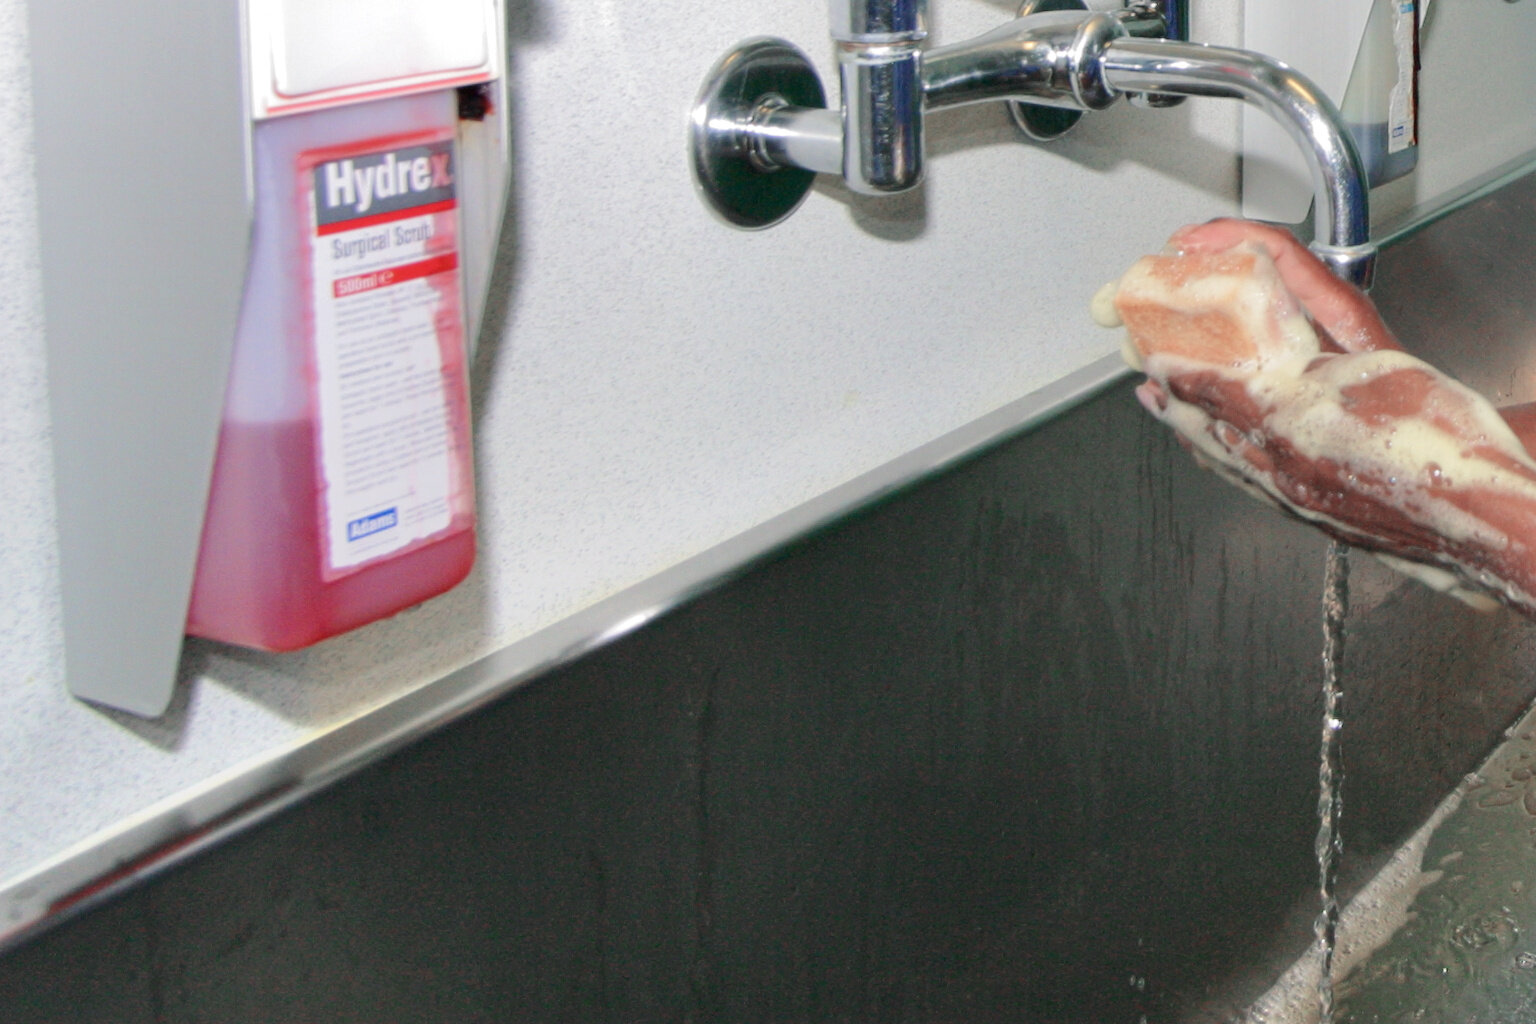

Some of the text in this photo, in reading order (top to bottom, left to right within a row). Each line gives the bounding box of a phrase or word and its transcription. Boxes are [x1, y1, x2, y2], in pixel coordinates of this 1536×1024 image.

[325, 152, 450, 213] Hydrex
[333, 228, 391, 260] Surgical
[338, 274, 378, 294] 500ml
[351, 512, 396, 539] Adams
